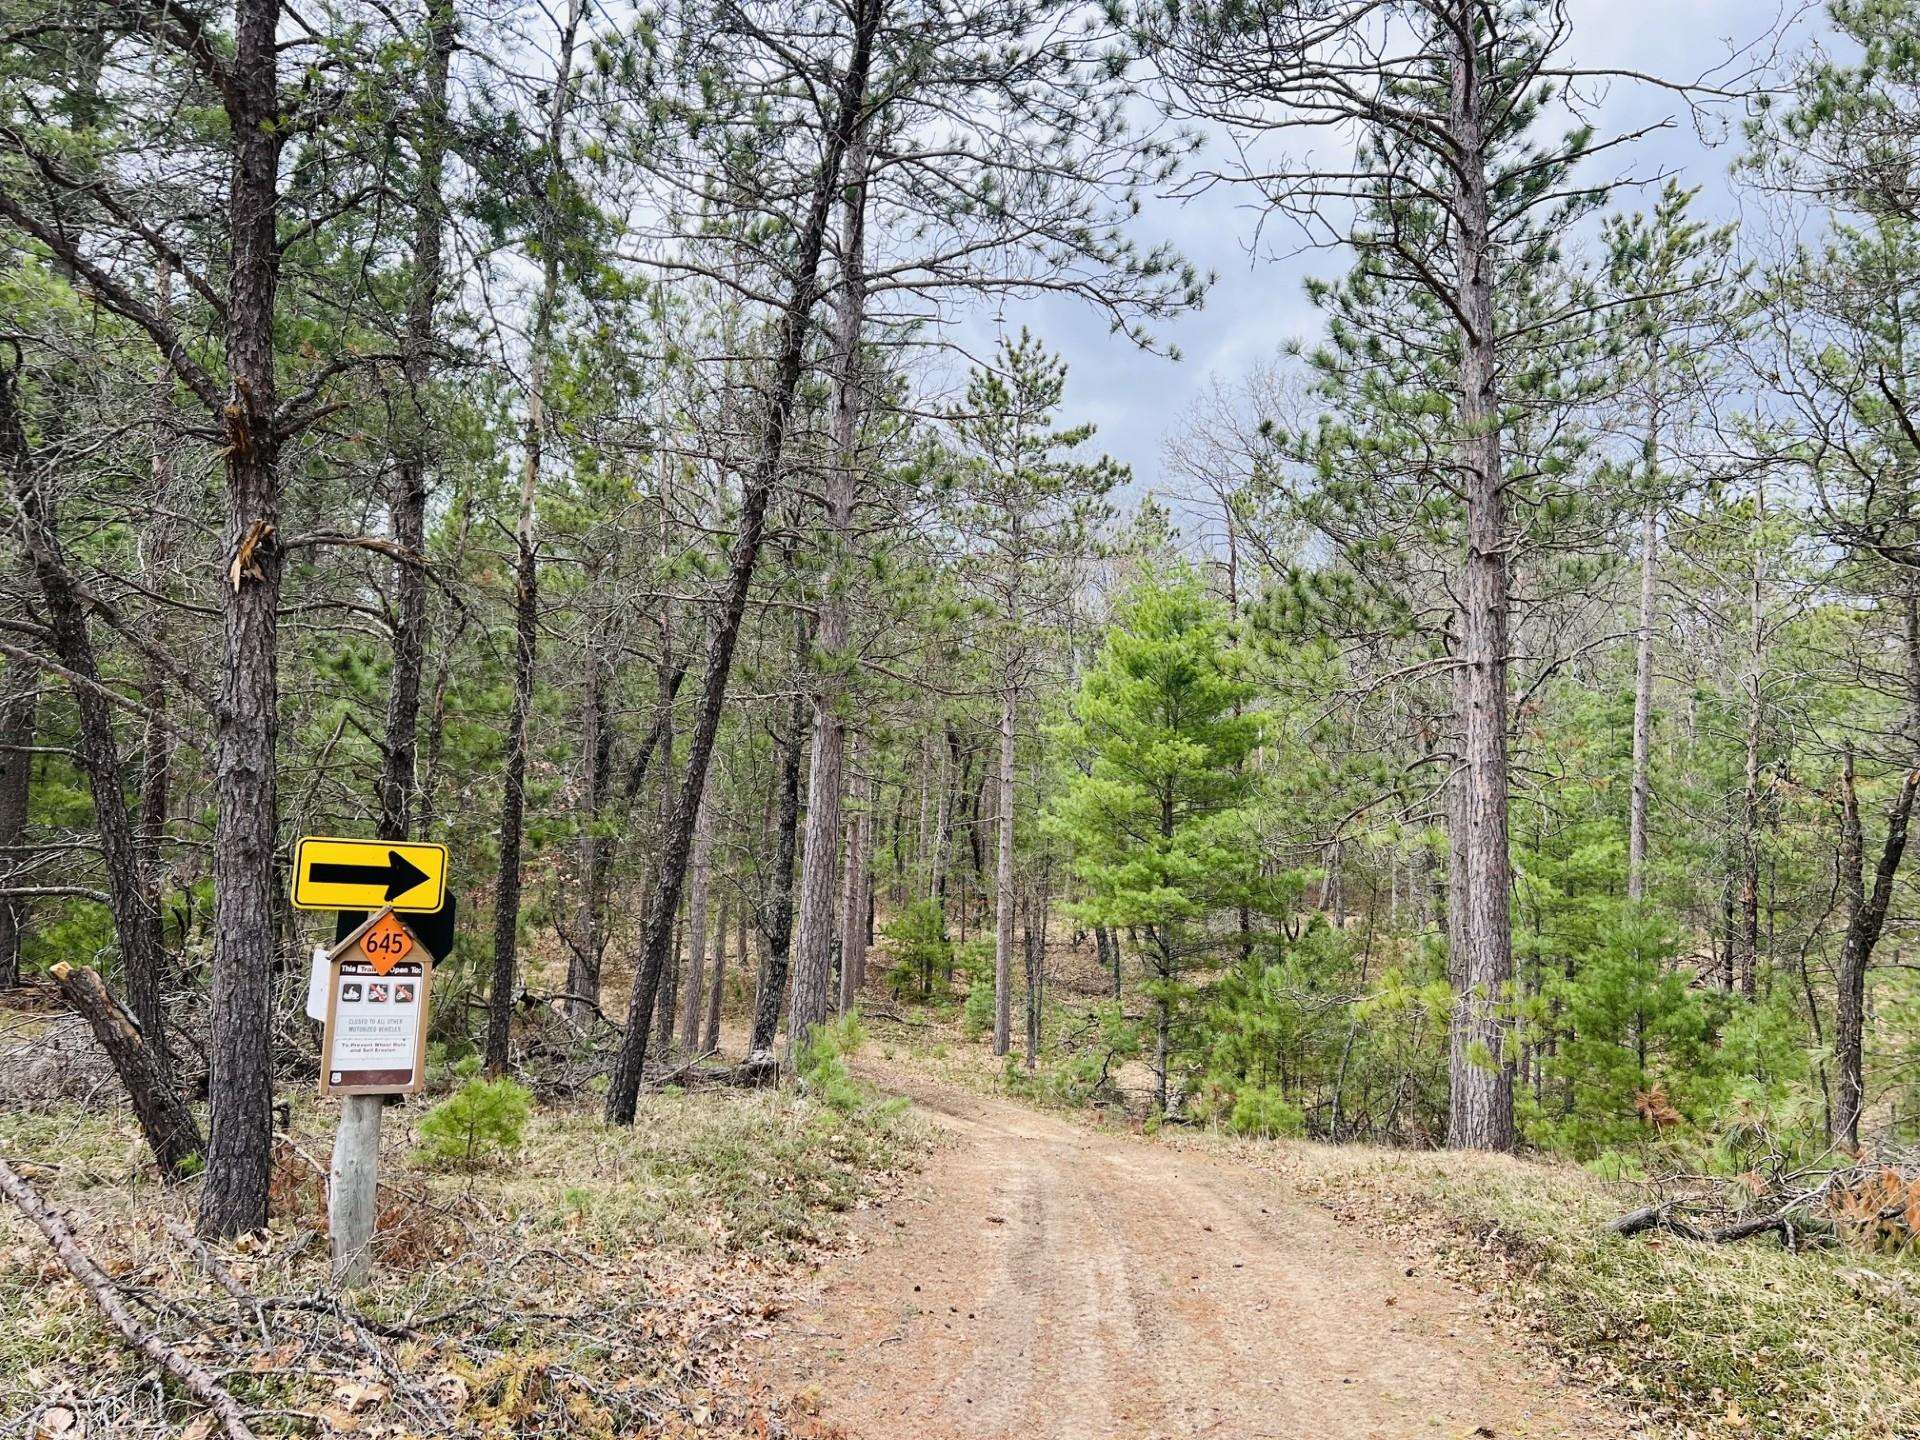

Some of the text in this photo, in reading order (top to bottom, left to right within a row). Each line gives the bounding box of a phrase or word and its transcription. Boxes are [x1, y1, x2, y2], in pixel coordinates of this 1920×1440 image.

[366, 932, 403, 954] 645
[341, 964, 357, 972] This
[390, 966, 409, 974] Open
